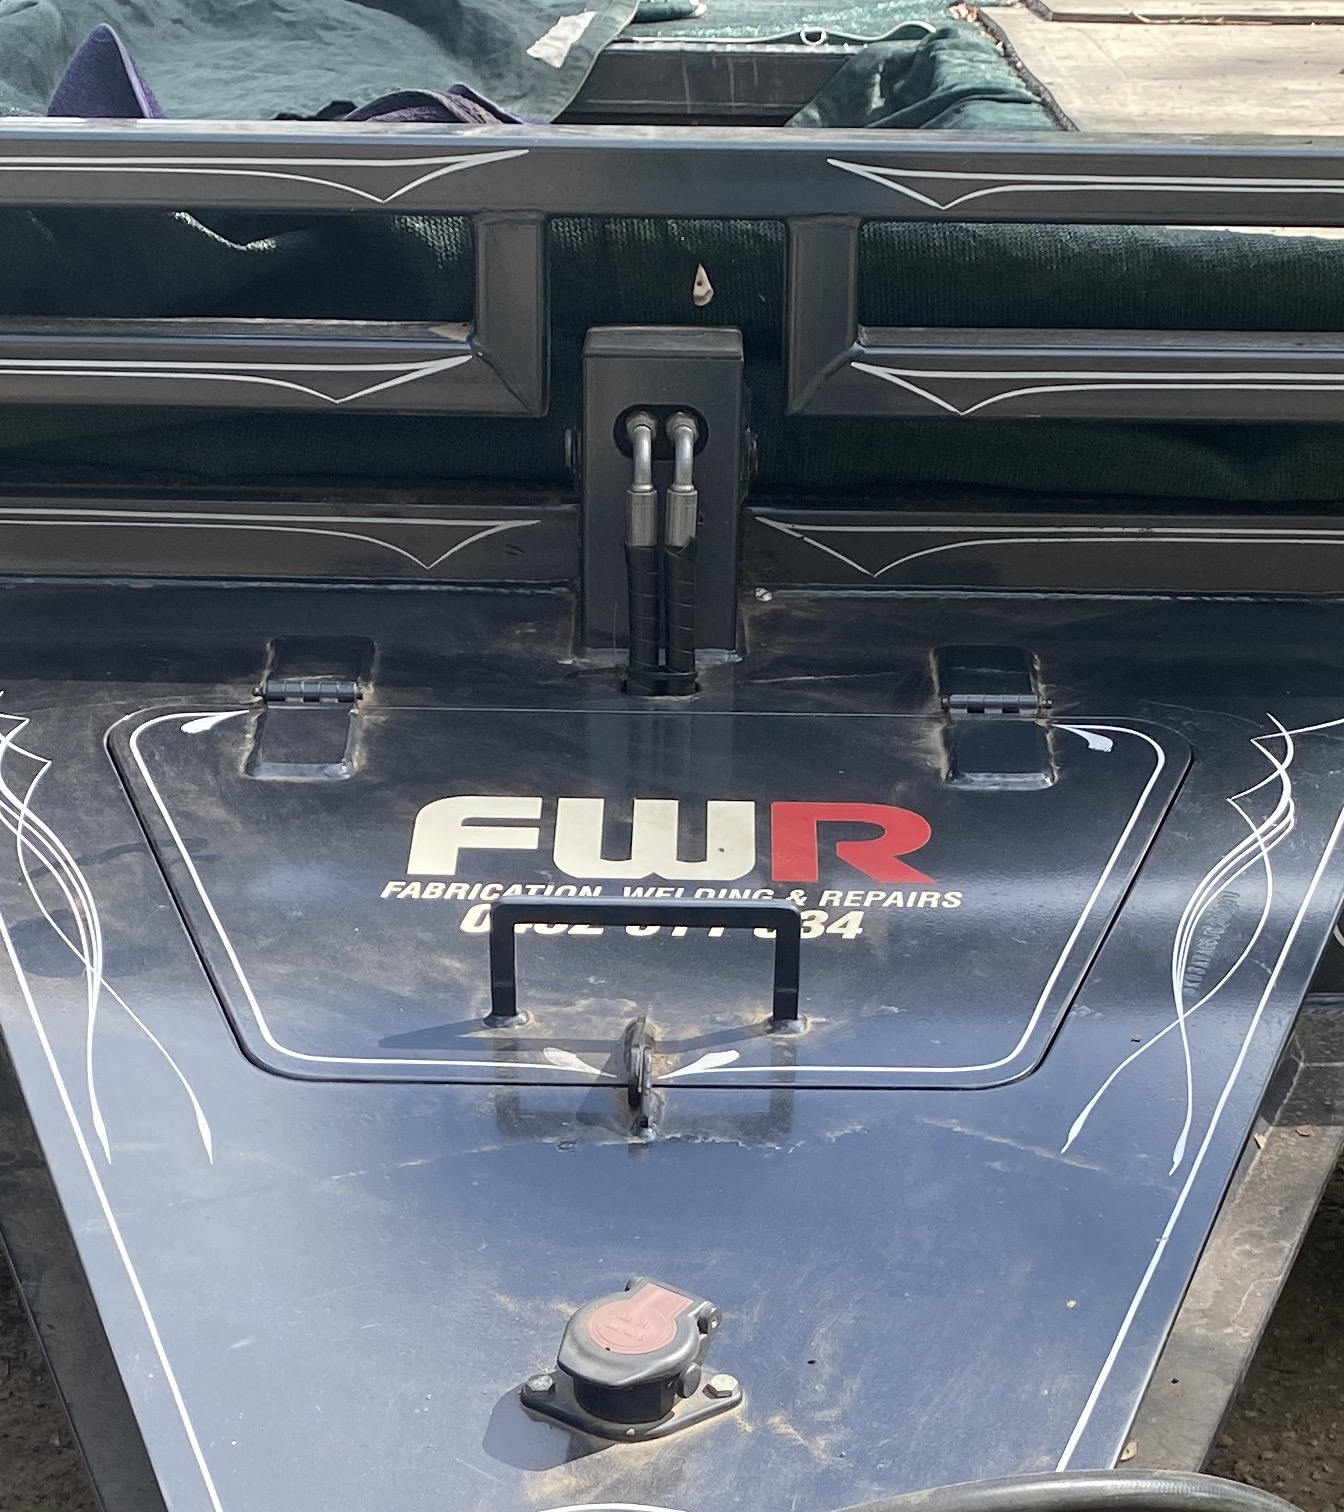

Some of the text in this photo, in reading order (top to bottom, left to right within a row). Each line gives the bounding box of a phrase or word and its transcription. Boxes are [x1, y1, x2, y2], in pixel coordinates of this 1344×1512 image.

[406, 795, 935, 884] FWR
[380, 880, 605, 901] FABRICATION
[785, 889, 807, 906] &
[818, 889, 963, 908] REPAIRS
